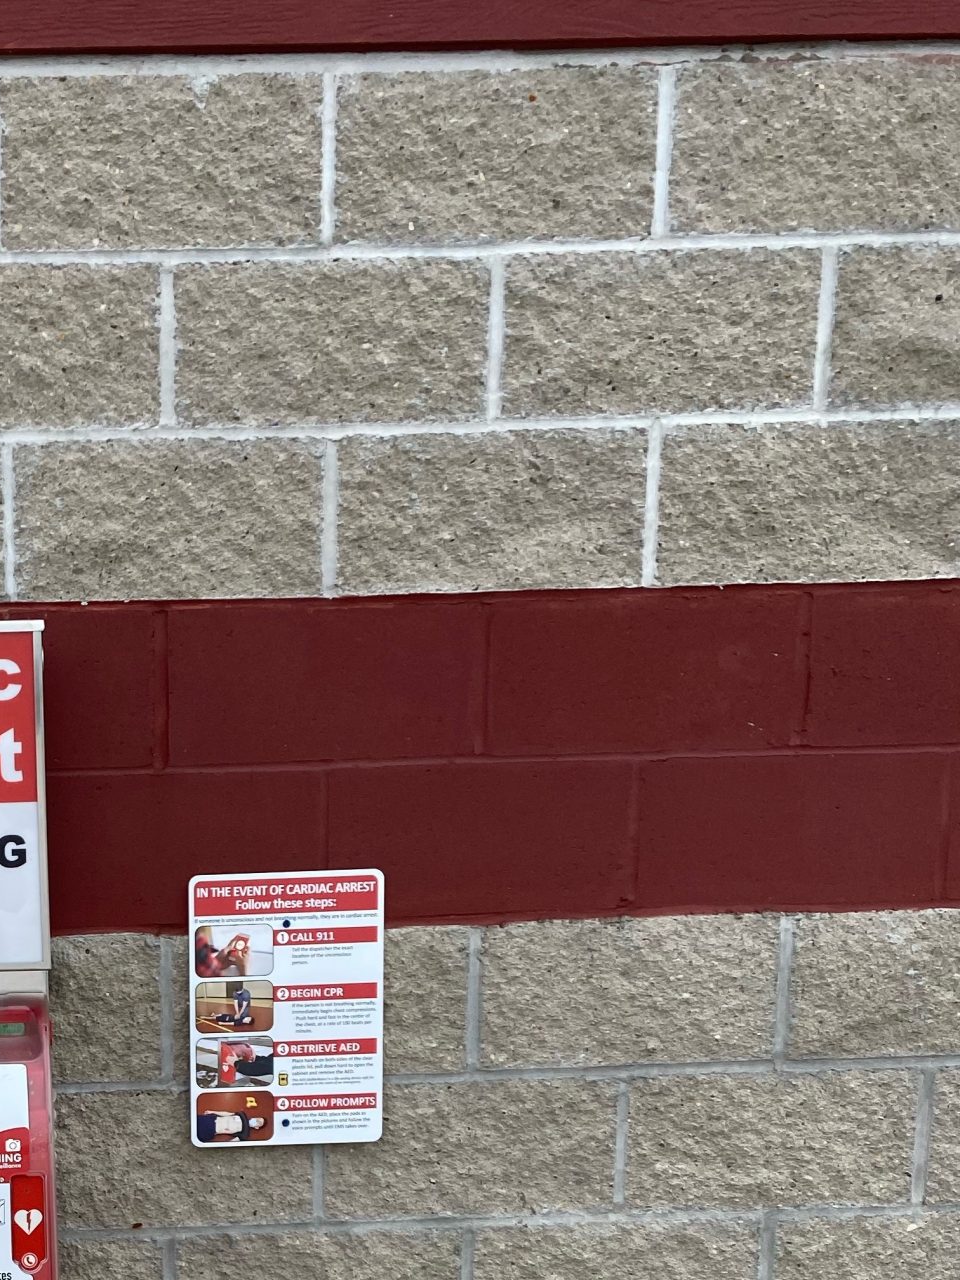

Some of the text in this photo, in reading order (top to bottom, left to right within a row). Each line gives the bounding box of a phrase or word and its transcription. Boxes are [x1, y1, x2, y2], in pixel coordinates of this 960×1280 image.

[197, 881, 375, 897] IN THE EVENT OF CARDIAC ARREST
[236, 898, 336, 910] Follow these steps:
[290, 933, 314, 941] CALL
[316, 932, 334, 940] 911
[291, 989, 321, 997] BEGIN
[324, 988, 343, 996] CPR
[291, 1044, 337, 1053] RETRIEVE
[339, 1043, 360, 1051] AED
[291, 1099, 328, 1108] FOLLOW
[331, 1097, 375, 1106] PROMPTS
